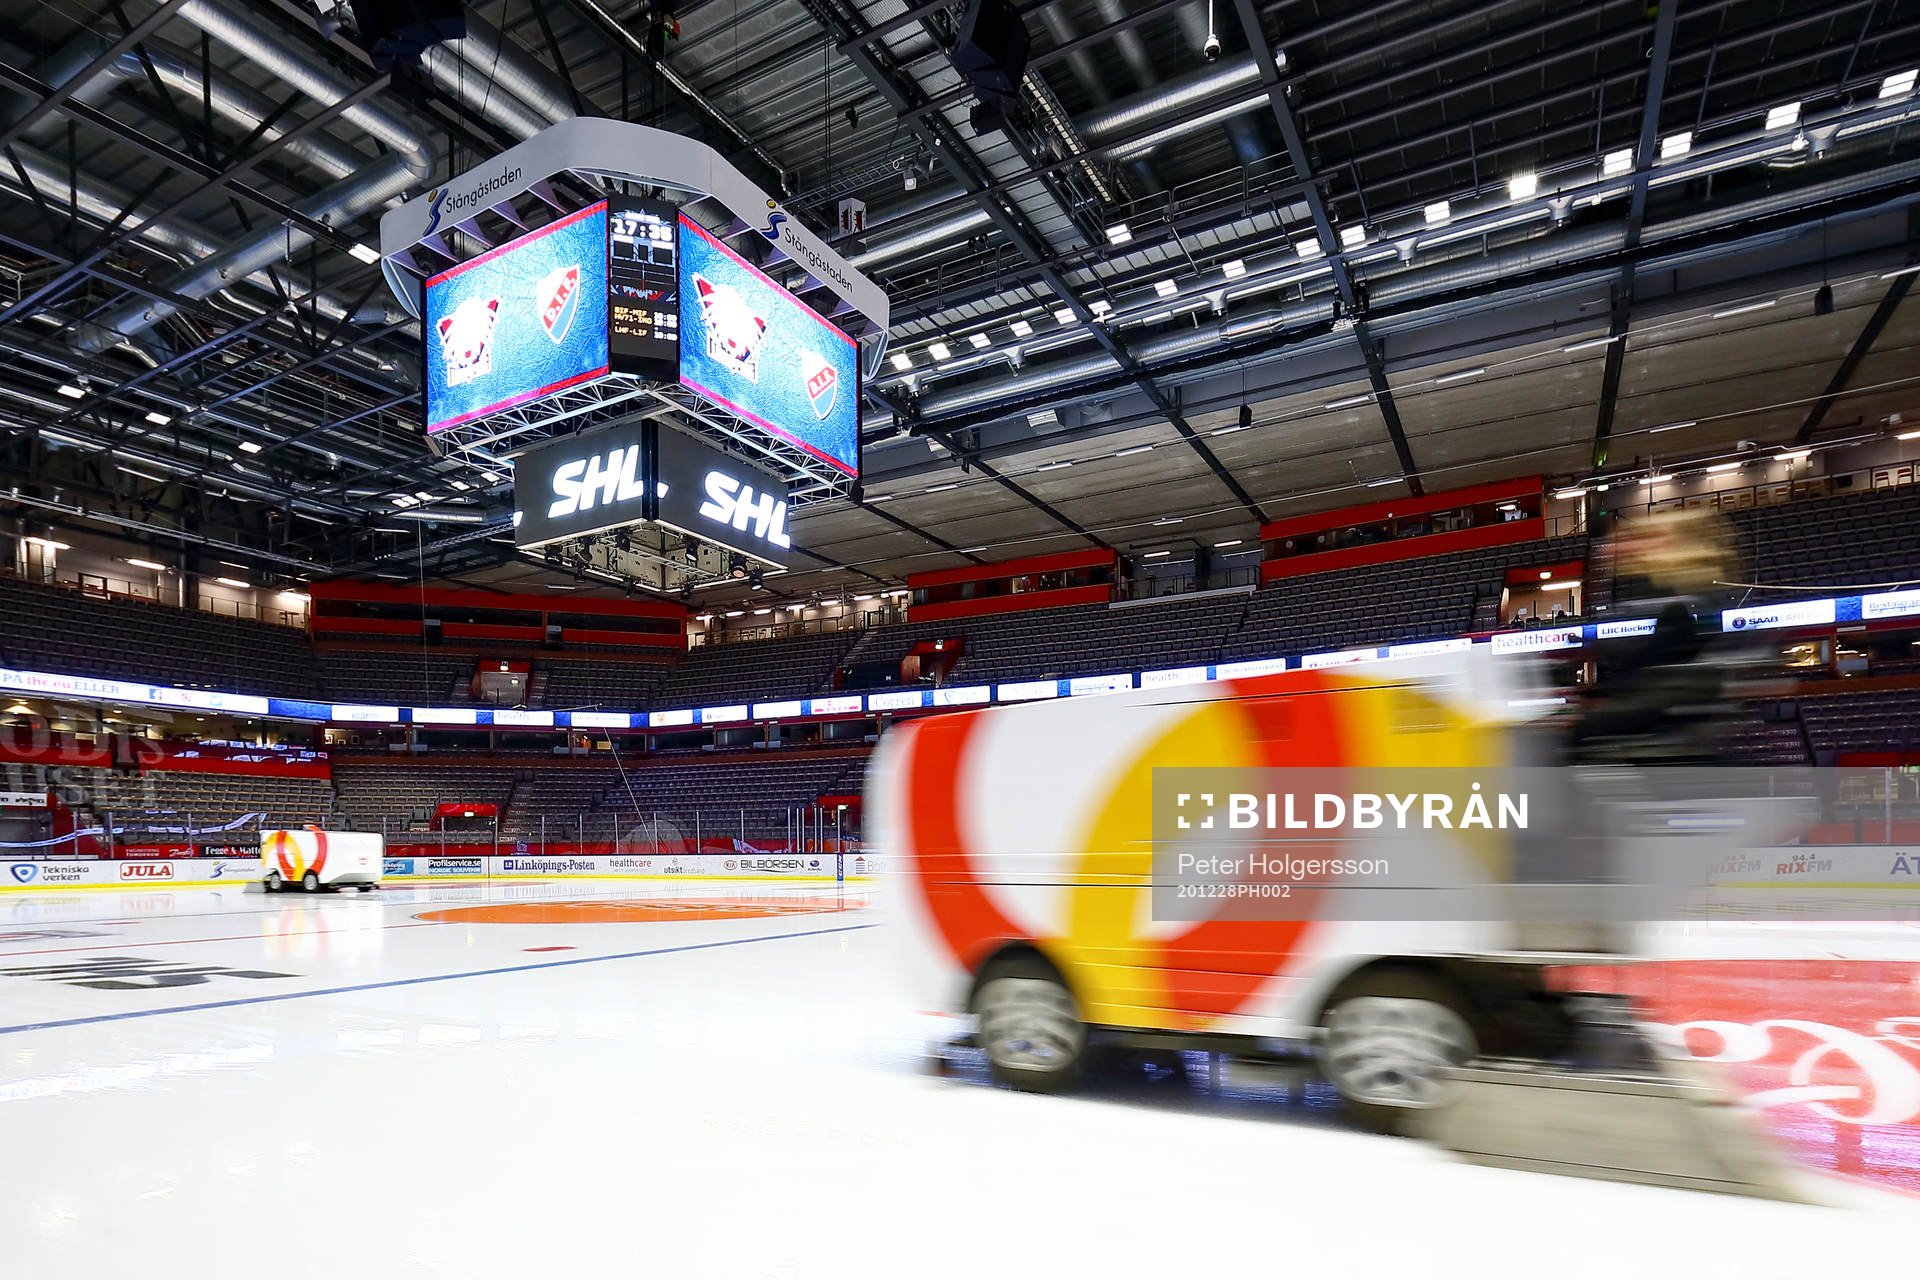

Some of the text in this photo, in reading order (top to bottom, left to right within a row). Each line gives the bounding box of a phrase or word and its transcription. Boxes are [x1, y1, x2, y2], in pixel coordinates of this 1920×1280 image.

[445, 166, 522, 213] Stångåstaden
[784, 227, 853, 293] Stångåstaden
[548, 444, 643, 518] SHL
[699, 471, 790, 549] SHL
[1748, 616, 1778, 625] SAAB
[1601, 626, 1620, 635] LHC
[74, 681, 119, 694] ELLER
[429, 859, 481, 867] Profilservice.se
[609, 858, 652, 867] healthcare
[1792, 853, 1815, 862] 94.4
[515, 860, 595, 873] Linköpings-Posten
[741, 858, 804, 869] BILBÖRSEN
[1776, 859, 1833, 875] RIXFM
[42, 865, 89, 874] Tekniska
[123, 865, 171, 877] JULA
[664, 866, 682, 874] utsikt
